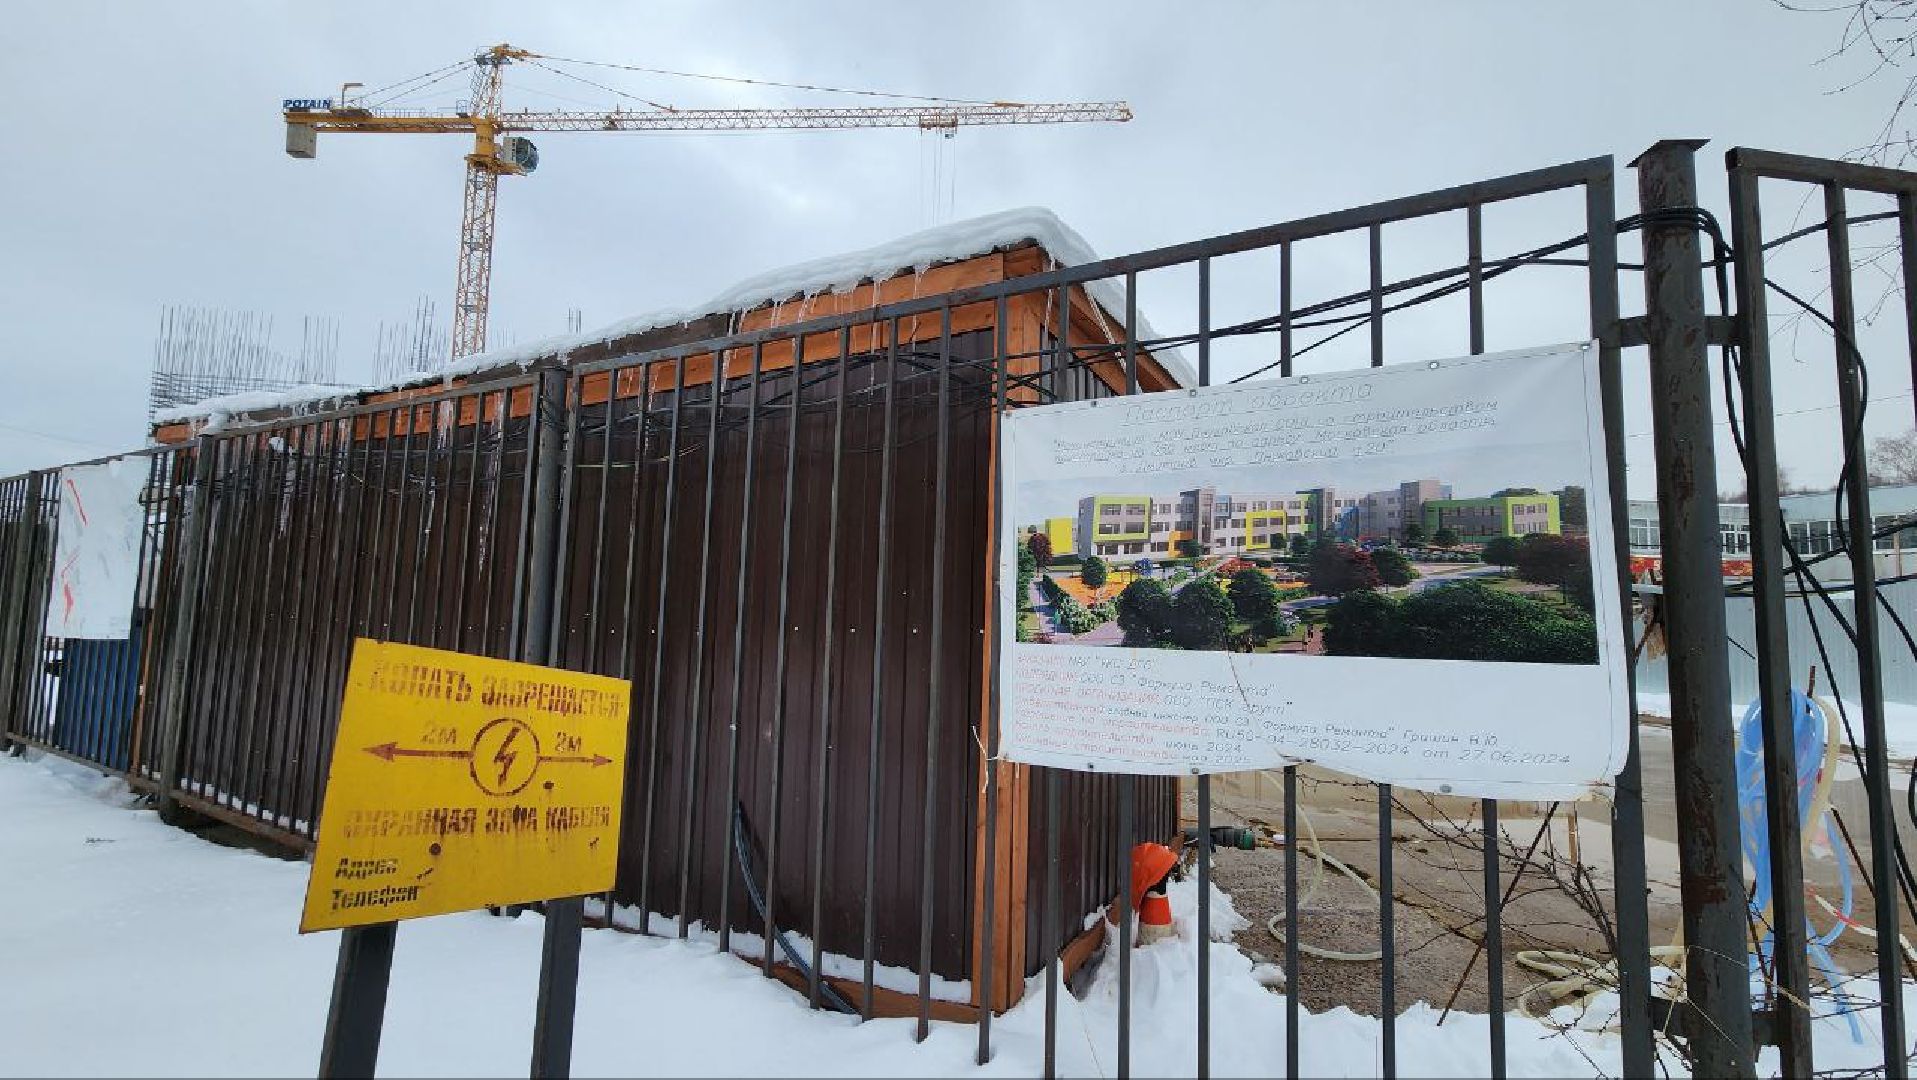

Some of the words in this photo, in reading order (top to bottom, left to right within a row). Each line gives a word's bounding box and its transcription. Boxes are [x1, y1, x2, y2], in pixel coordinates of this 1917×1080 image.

[283, 99, 331, 109] POTAIN
[1126, 401, 1233, 423] Паспорт
[1251, 384, 1372, 408] объекта
[370, 661, 472, 702] КОПАТЬ
[482, 674, 623, 718] ЗАПРЕЩАЕТСЯ
[335, 857, 398, 881] Адрес
[332, 884, 420, 911] Телефон
